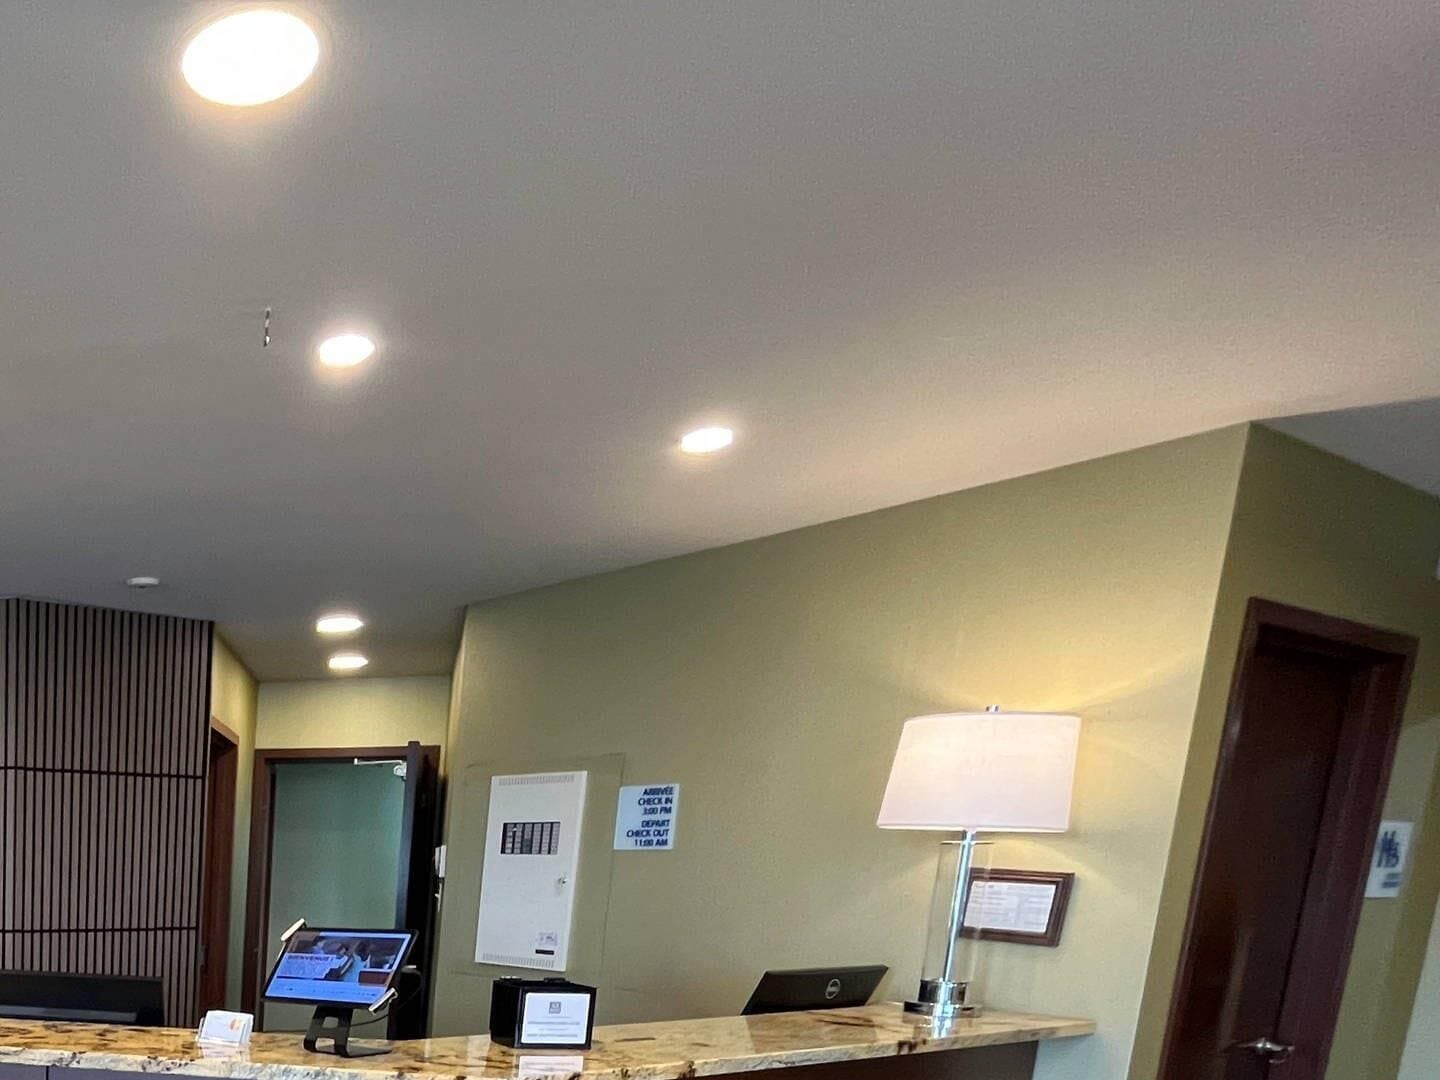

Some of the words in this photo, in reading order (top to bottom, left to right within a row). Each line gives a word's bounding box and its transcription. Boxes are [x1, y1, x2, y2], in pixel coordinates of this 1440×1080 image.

[638, 797, 663, 806] CHECK
[664, 797, 673, 805] IN
[626, 830, 651, 838] CHECK
[653, 829, 669, 837] OUT
